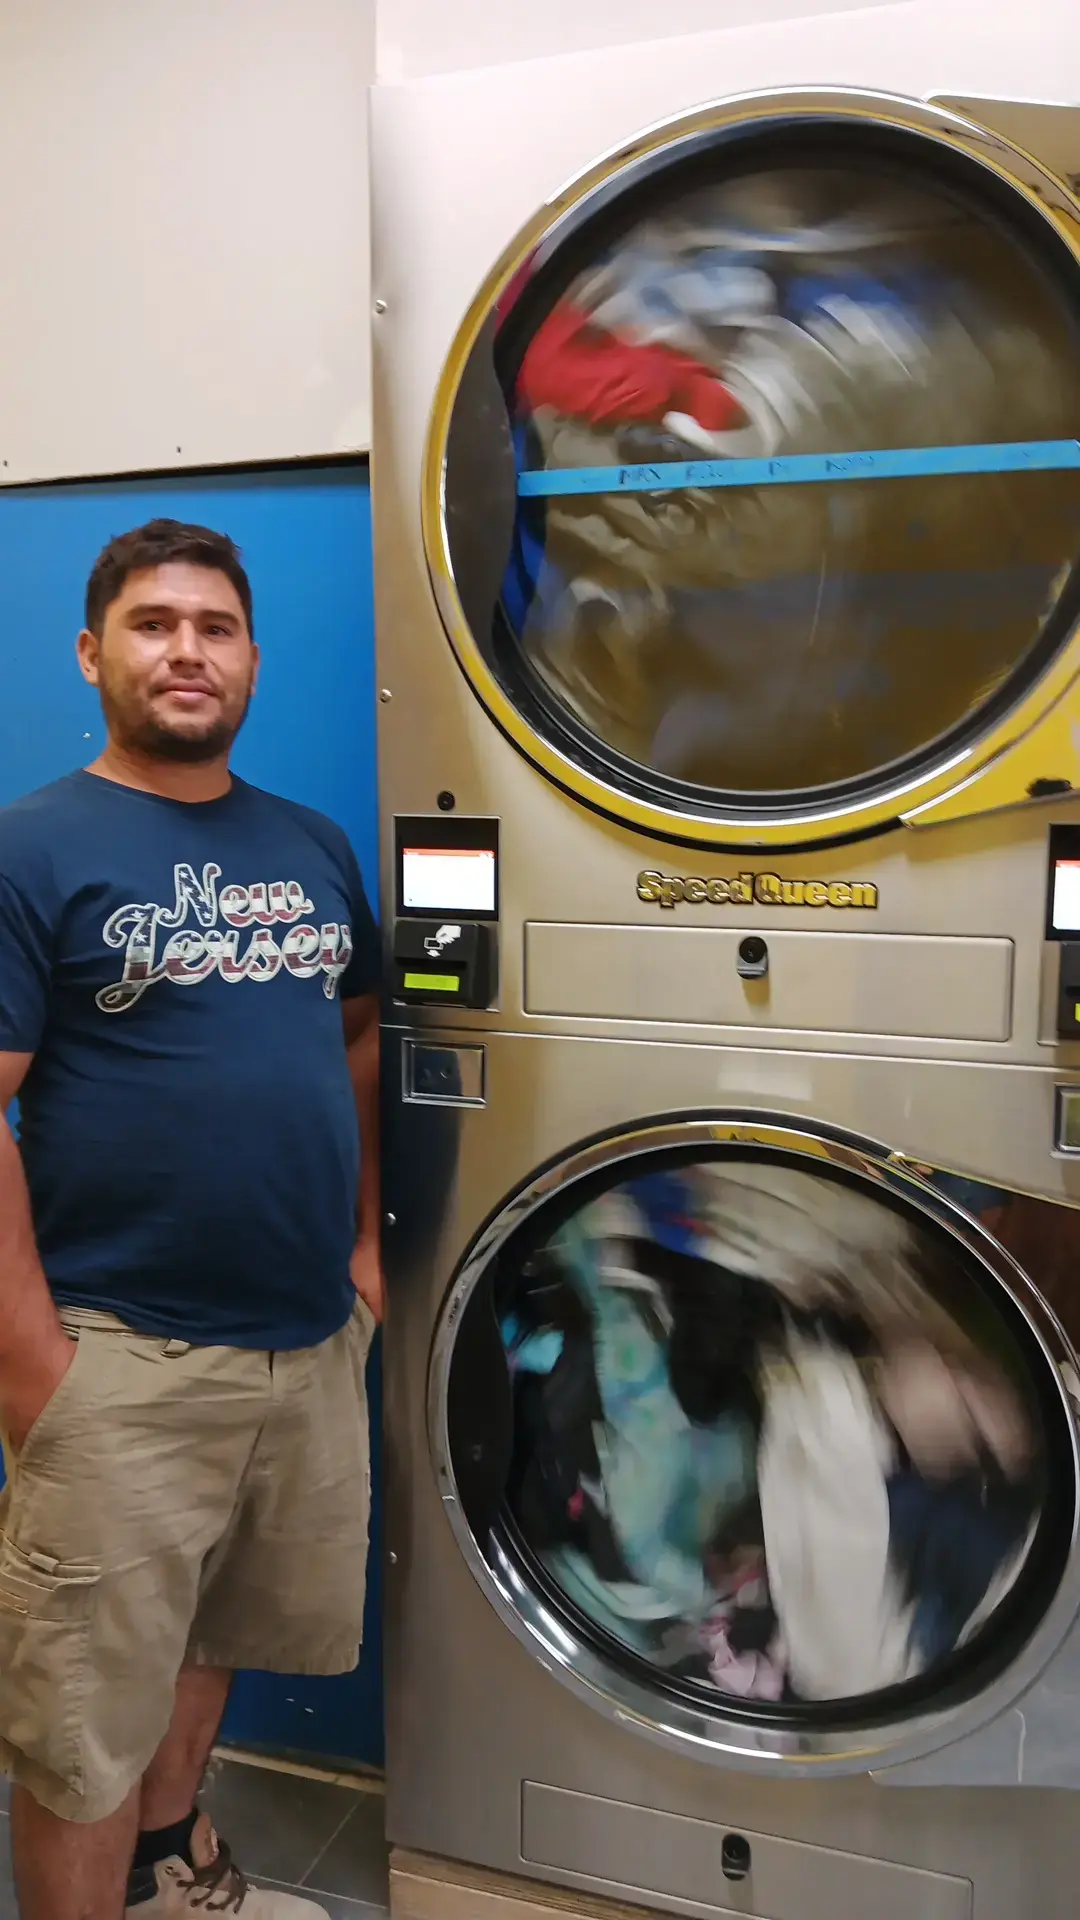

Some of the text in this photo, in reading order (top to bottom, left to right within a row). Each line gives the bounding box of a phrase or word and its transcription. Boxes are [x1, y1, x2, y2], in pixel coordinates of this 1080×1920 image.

[157, 863, 315, 927] New
[637, 870, 878, 909] Speed Queen
[95, 903, 353, 1013] Jersey
